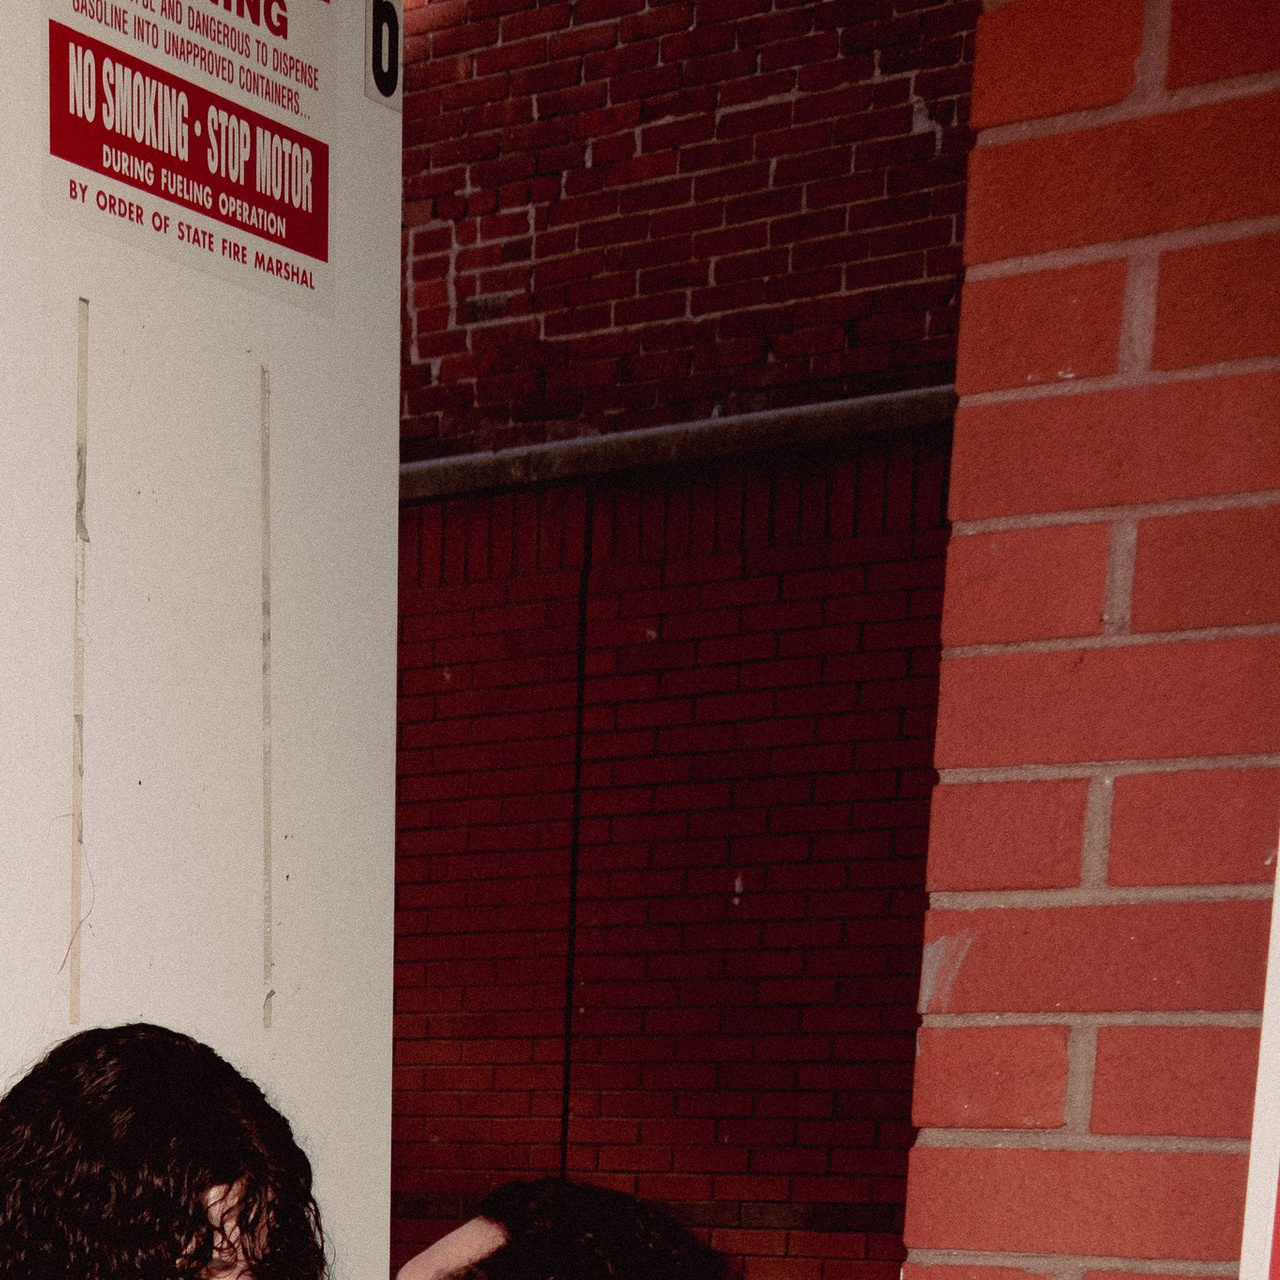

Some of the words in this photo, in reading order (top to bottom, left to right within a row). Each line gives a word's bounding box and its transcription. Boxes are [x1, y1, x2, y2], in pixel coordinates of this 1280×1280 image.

[72, 0, 128, 35] GASOLINE
[134, 15, 158, 49] INTO
[164, 29, 234, 84] UNAPPROVED
[161, 0, 182, 25] AND
[188, 6, 250, 59] DANGEROUS
[255, 39, 268, 67] TO
[272, 48, 319, 91] DISPENSE
[69, 42, 96, 123] NO
[102, 57, 189, 162] SMOKING
[207, 104, 251, 185] STOP
[256, 125, 313, 213] MOTOR
[69, 179, 88, 204] BY
[96, 190, 144, 226] ORDER
[152, 211, 170, 234] OF
[177, 221, 214, 252] STATE
[222, 238, 248, 265] FIRE
[254, 251, 316, 290] MARSHAL
[103, 144, 154, 186] DURING
[161, 168, 213, 210] FUELING
[218, 192, 286, 238] OPERATION
